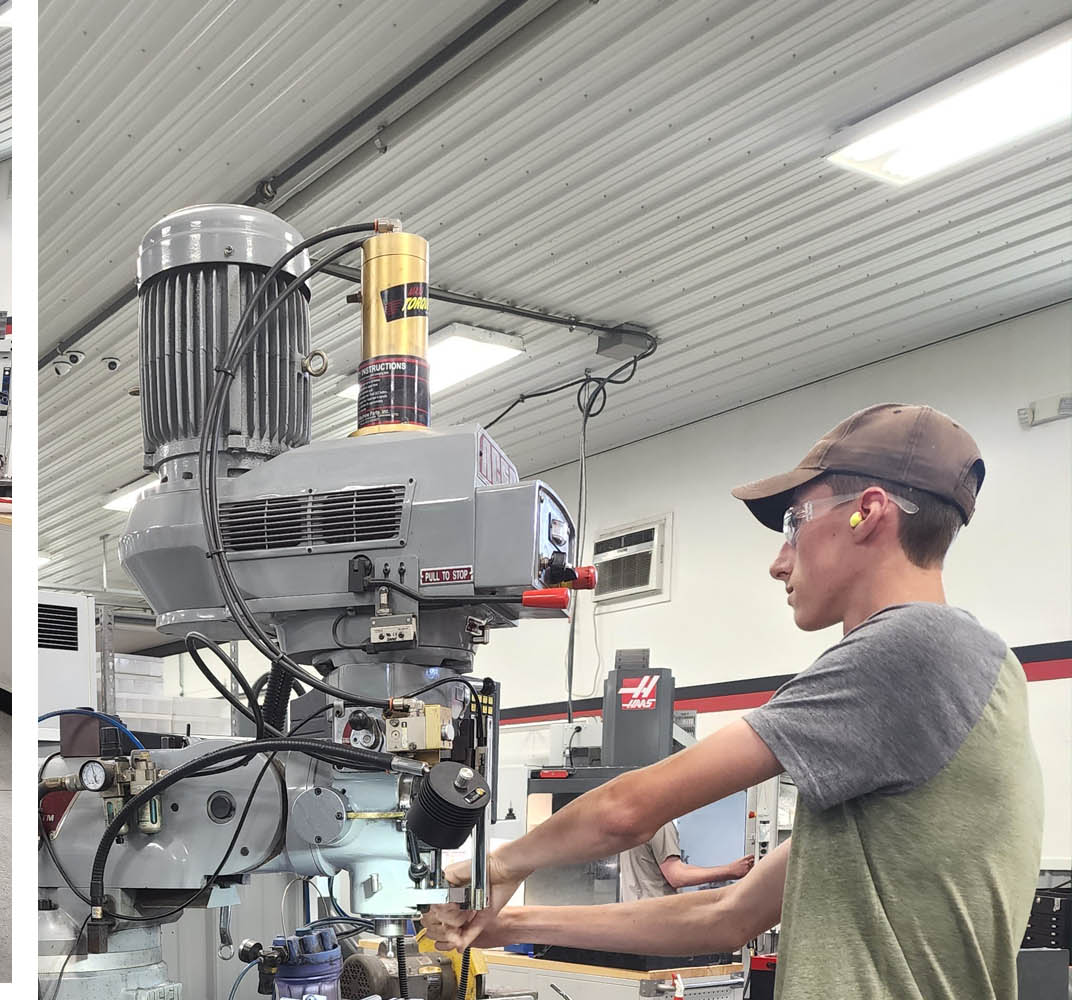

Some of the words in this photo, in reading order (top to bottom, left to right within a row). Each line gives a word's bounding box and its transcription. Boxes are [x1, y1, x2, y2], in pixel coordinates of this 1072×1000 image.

[425, 571, 440, 582] PULL
[442, 571, 450, 581] TO
[453, 570, 468, 580] STOP
